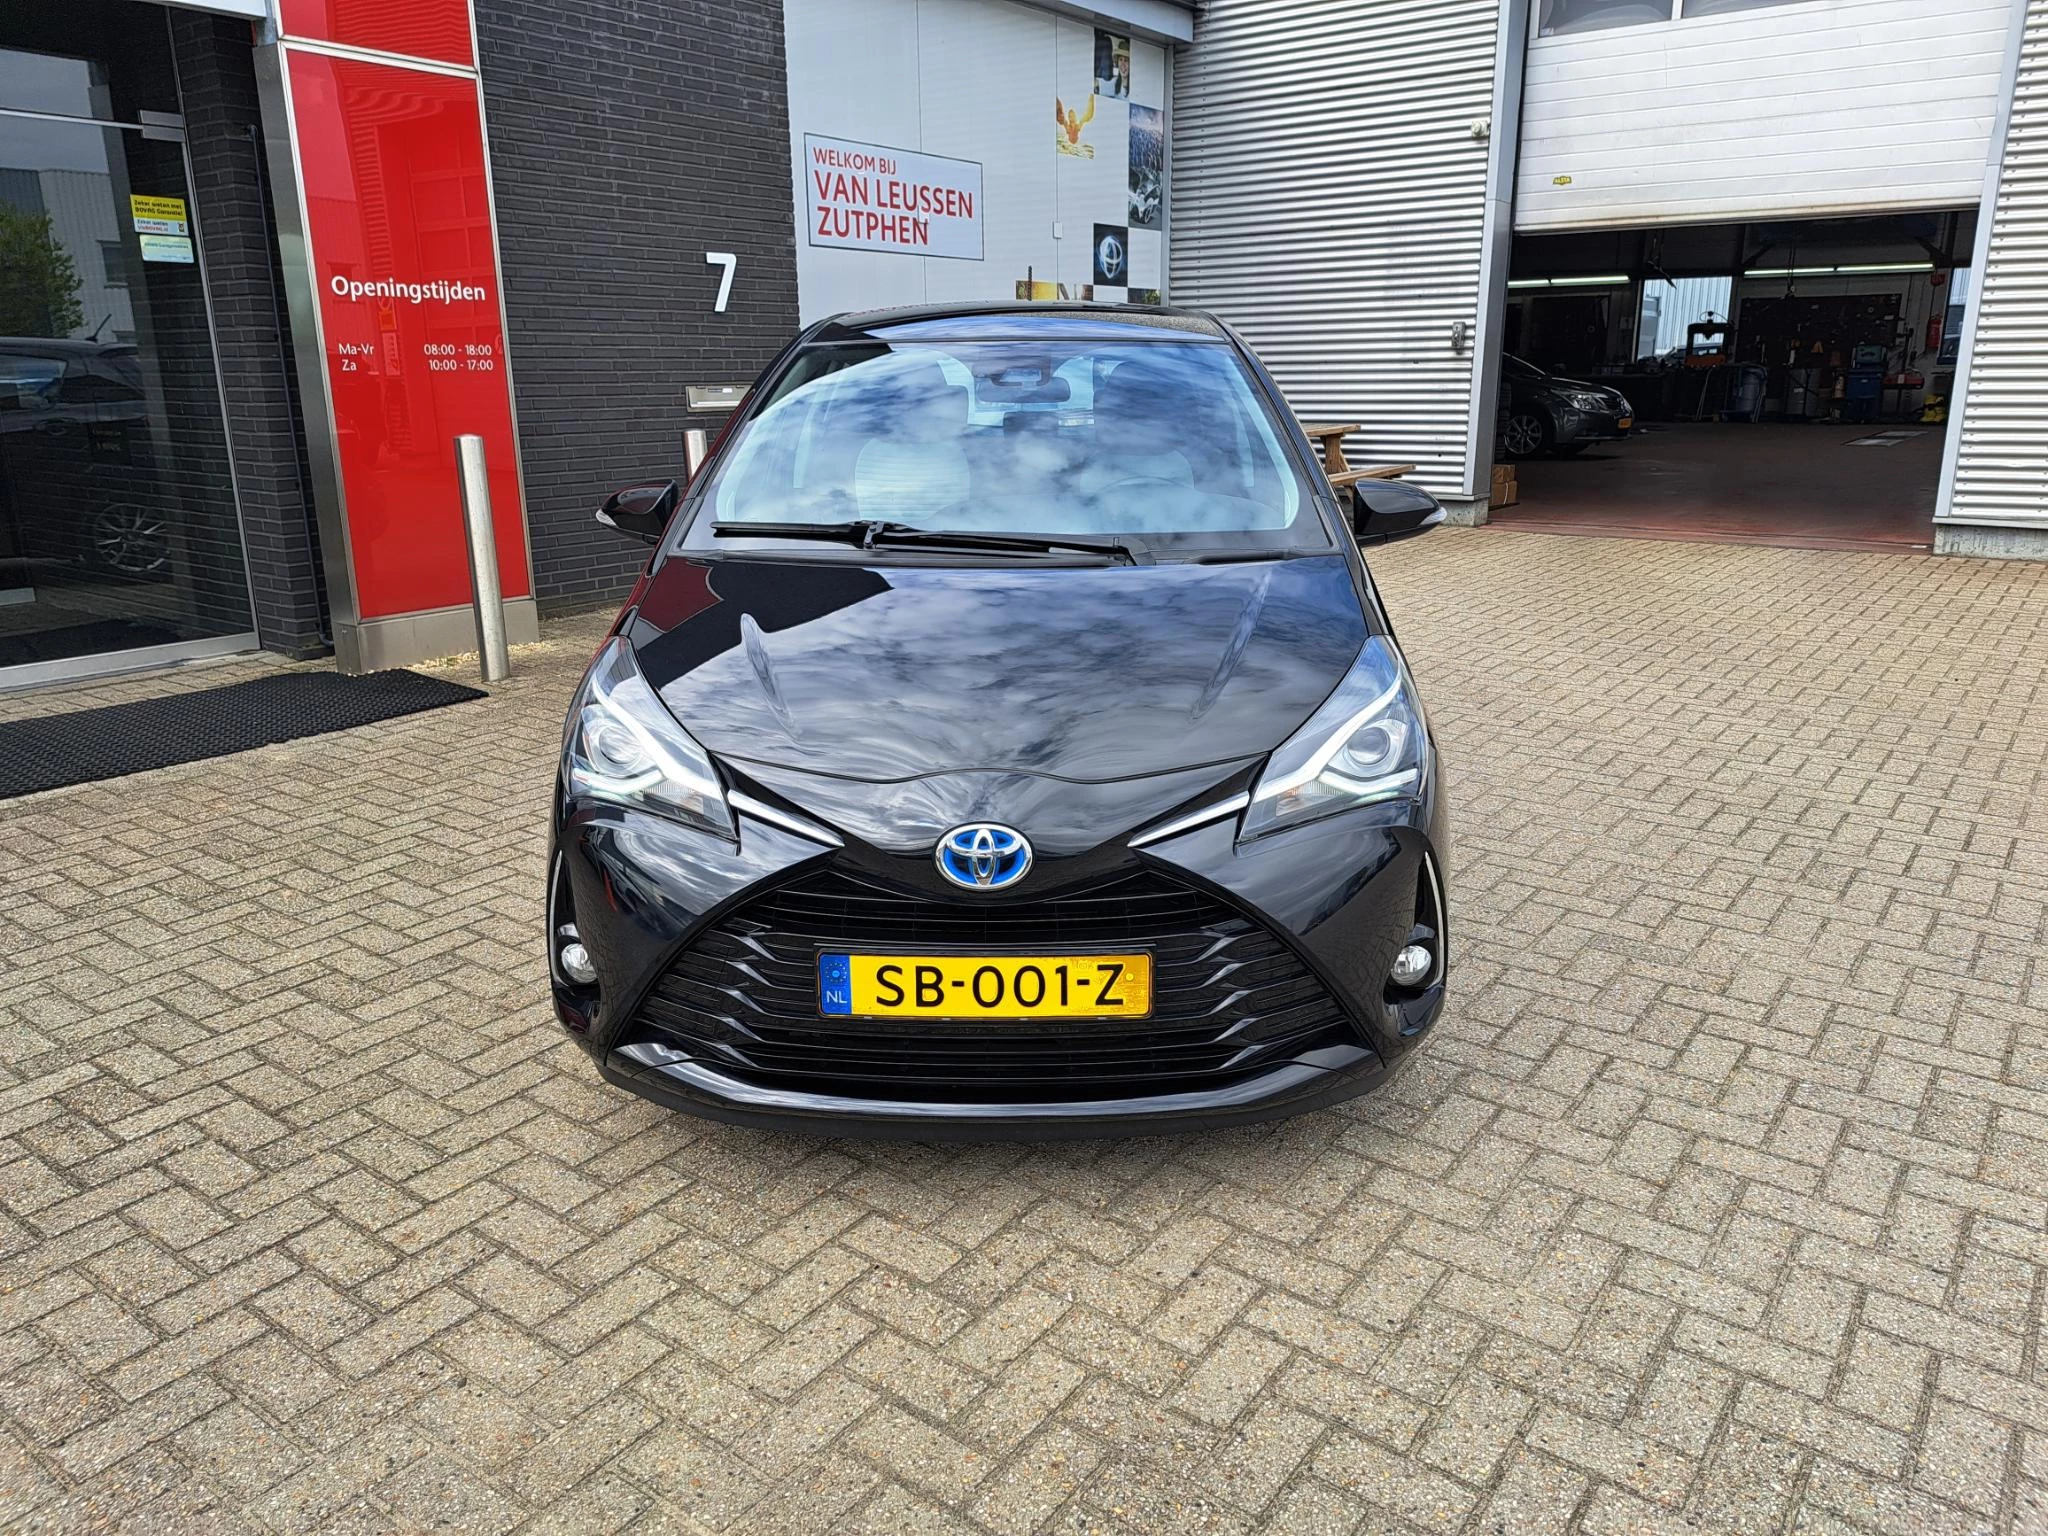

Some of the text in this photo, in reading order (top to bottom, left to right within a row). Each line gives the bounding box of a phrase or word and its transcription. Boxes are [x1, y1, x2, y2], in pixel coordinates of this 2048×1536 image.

[813, 147, 896, 175] WELKOM BIJ
[814, 170, 973, 219] VAN LEUSSEN
[817, 206, 928, 245] ZUTPHEN
[331, 275, 486, 305] Openingstijden
[706, 252, 737, 312] 7
[338, 343, 375, 355] Ma-Vr
[424, 344, 455, 355] 08:00
[465, 344, 492, 356] 18:00
[342, 359, 357, 371] Za
[429, 359, 457, 371] 10:00
[467, 359, 494, 371] 17:00
[825, 989, 848, 1004] NL
[875, 963, 1124, 1008] SB-001-Z
